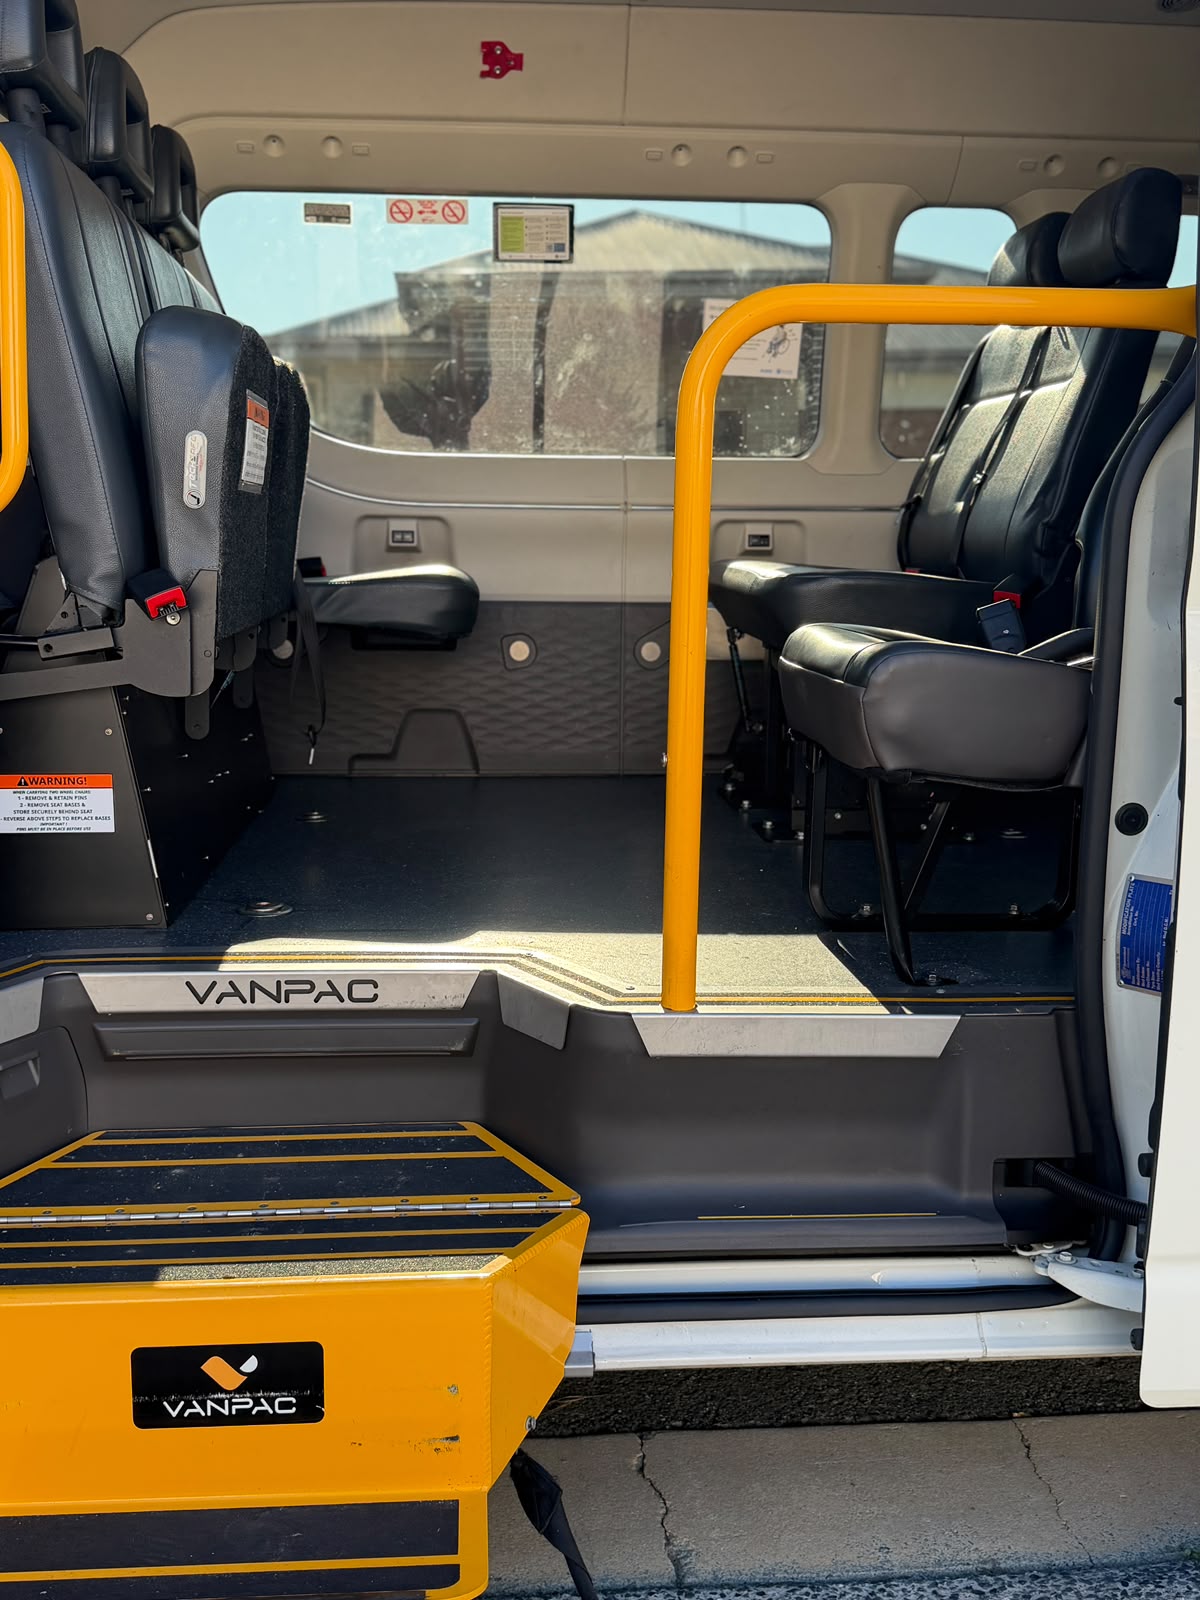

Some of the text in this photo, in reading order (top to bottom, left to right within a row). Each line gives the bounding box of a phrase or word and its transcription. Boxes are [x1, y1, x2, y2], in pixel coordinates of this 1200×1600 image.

[28, 776, 87, 786] WARNING!
[1122, 898, 1131, 935] MODIFICATION
[186, 979, 378, 1004] VANPAC
[162, 1396, 296, 1418] VANPAC
